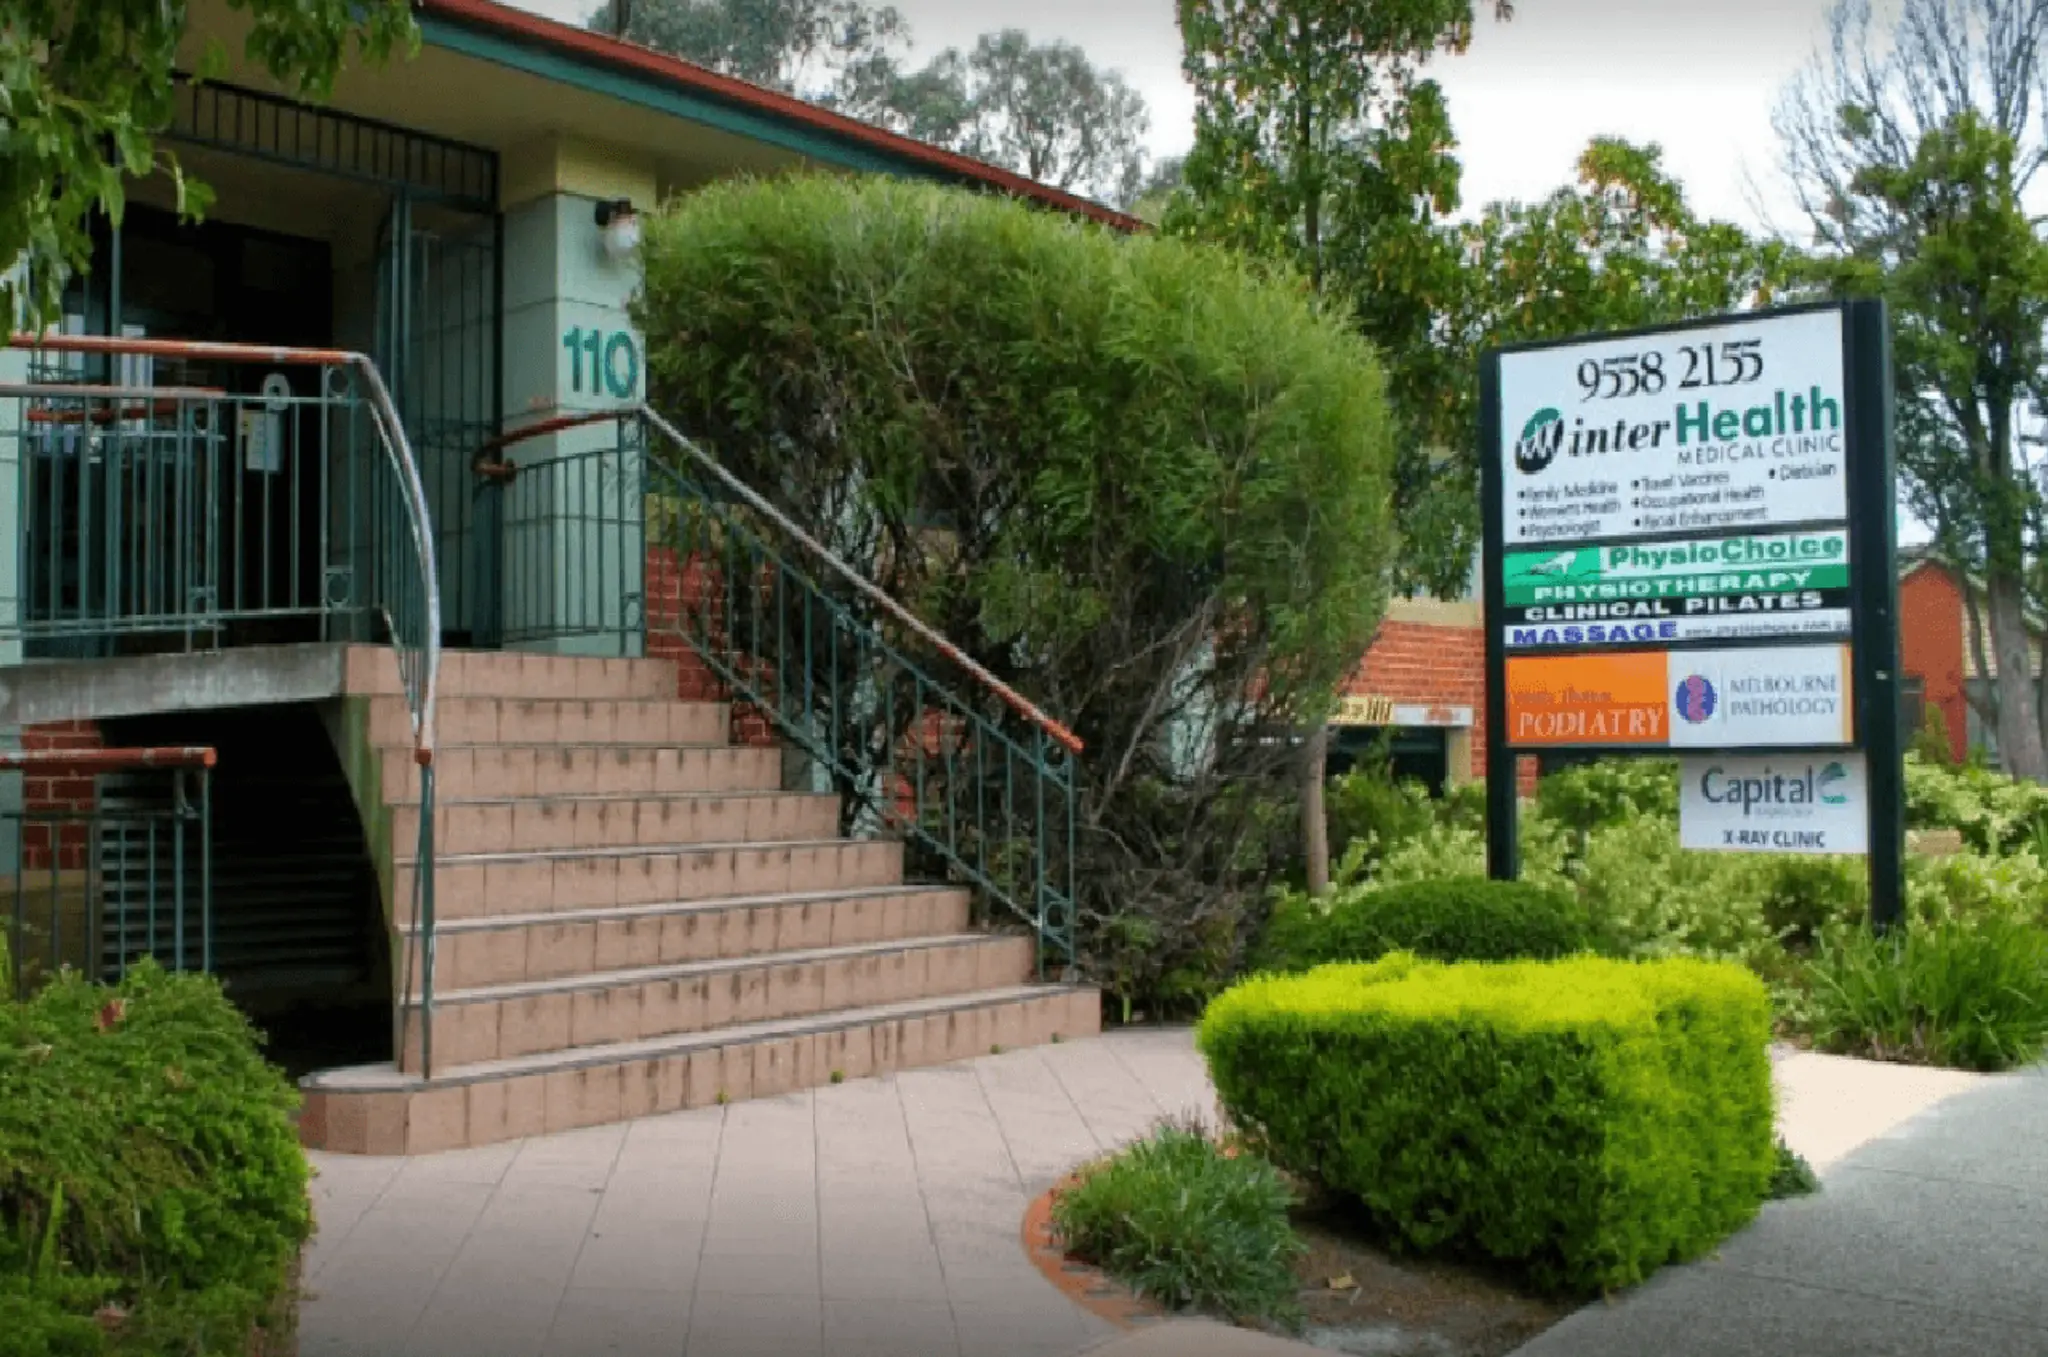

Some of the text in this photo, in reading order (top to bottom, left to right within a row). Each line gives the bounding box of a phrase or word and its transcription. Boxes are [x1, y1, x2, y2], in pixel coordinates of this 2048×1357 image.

[563, 325, 638, 398] 110
[1576, 337, 1764, 402] 9558 2155
[1677, 434, 1841, 465] MEDICAL CLINIC
[1725, 485, 1764, 502] Health
[1608, 535, 1843, 571] PhysioChoice
[1534, 570, 1812, 600] PHYSIOTHERAPY
[1525, 591, 1823, 621] CLINICAL PILATES
[1512, 621, 1679, 644] MASSAGE
[1517, 707, 1664, 737] PODIATRY
[1731, 698, 1836, 716] PATHOLOGY
[1701, 764, 1813, 815] Capital
[1773, 830, 1826, 848] CLINIC
